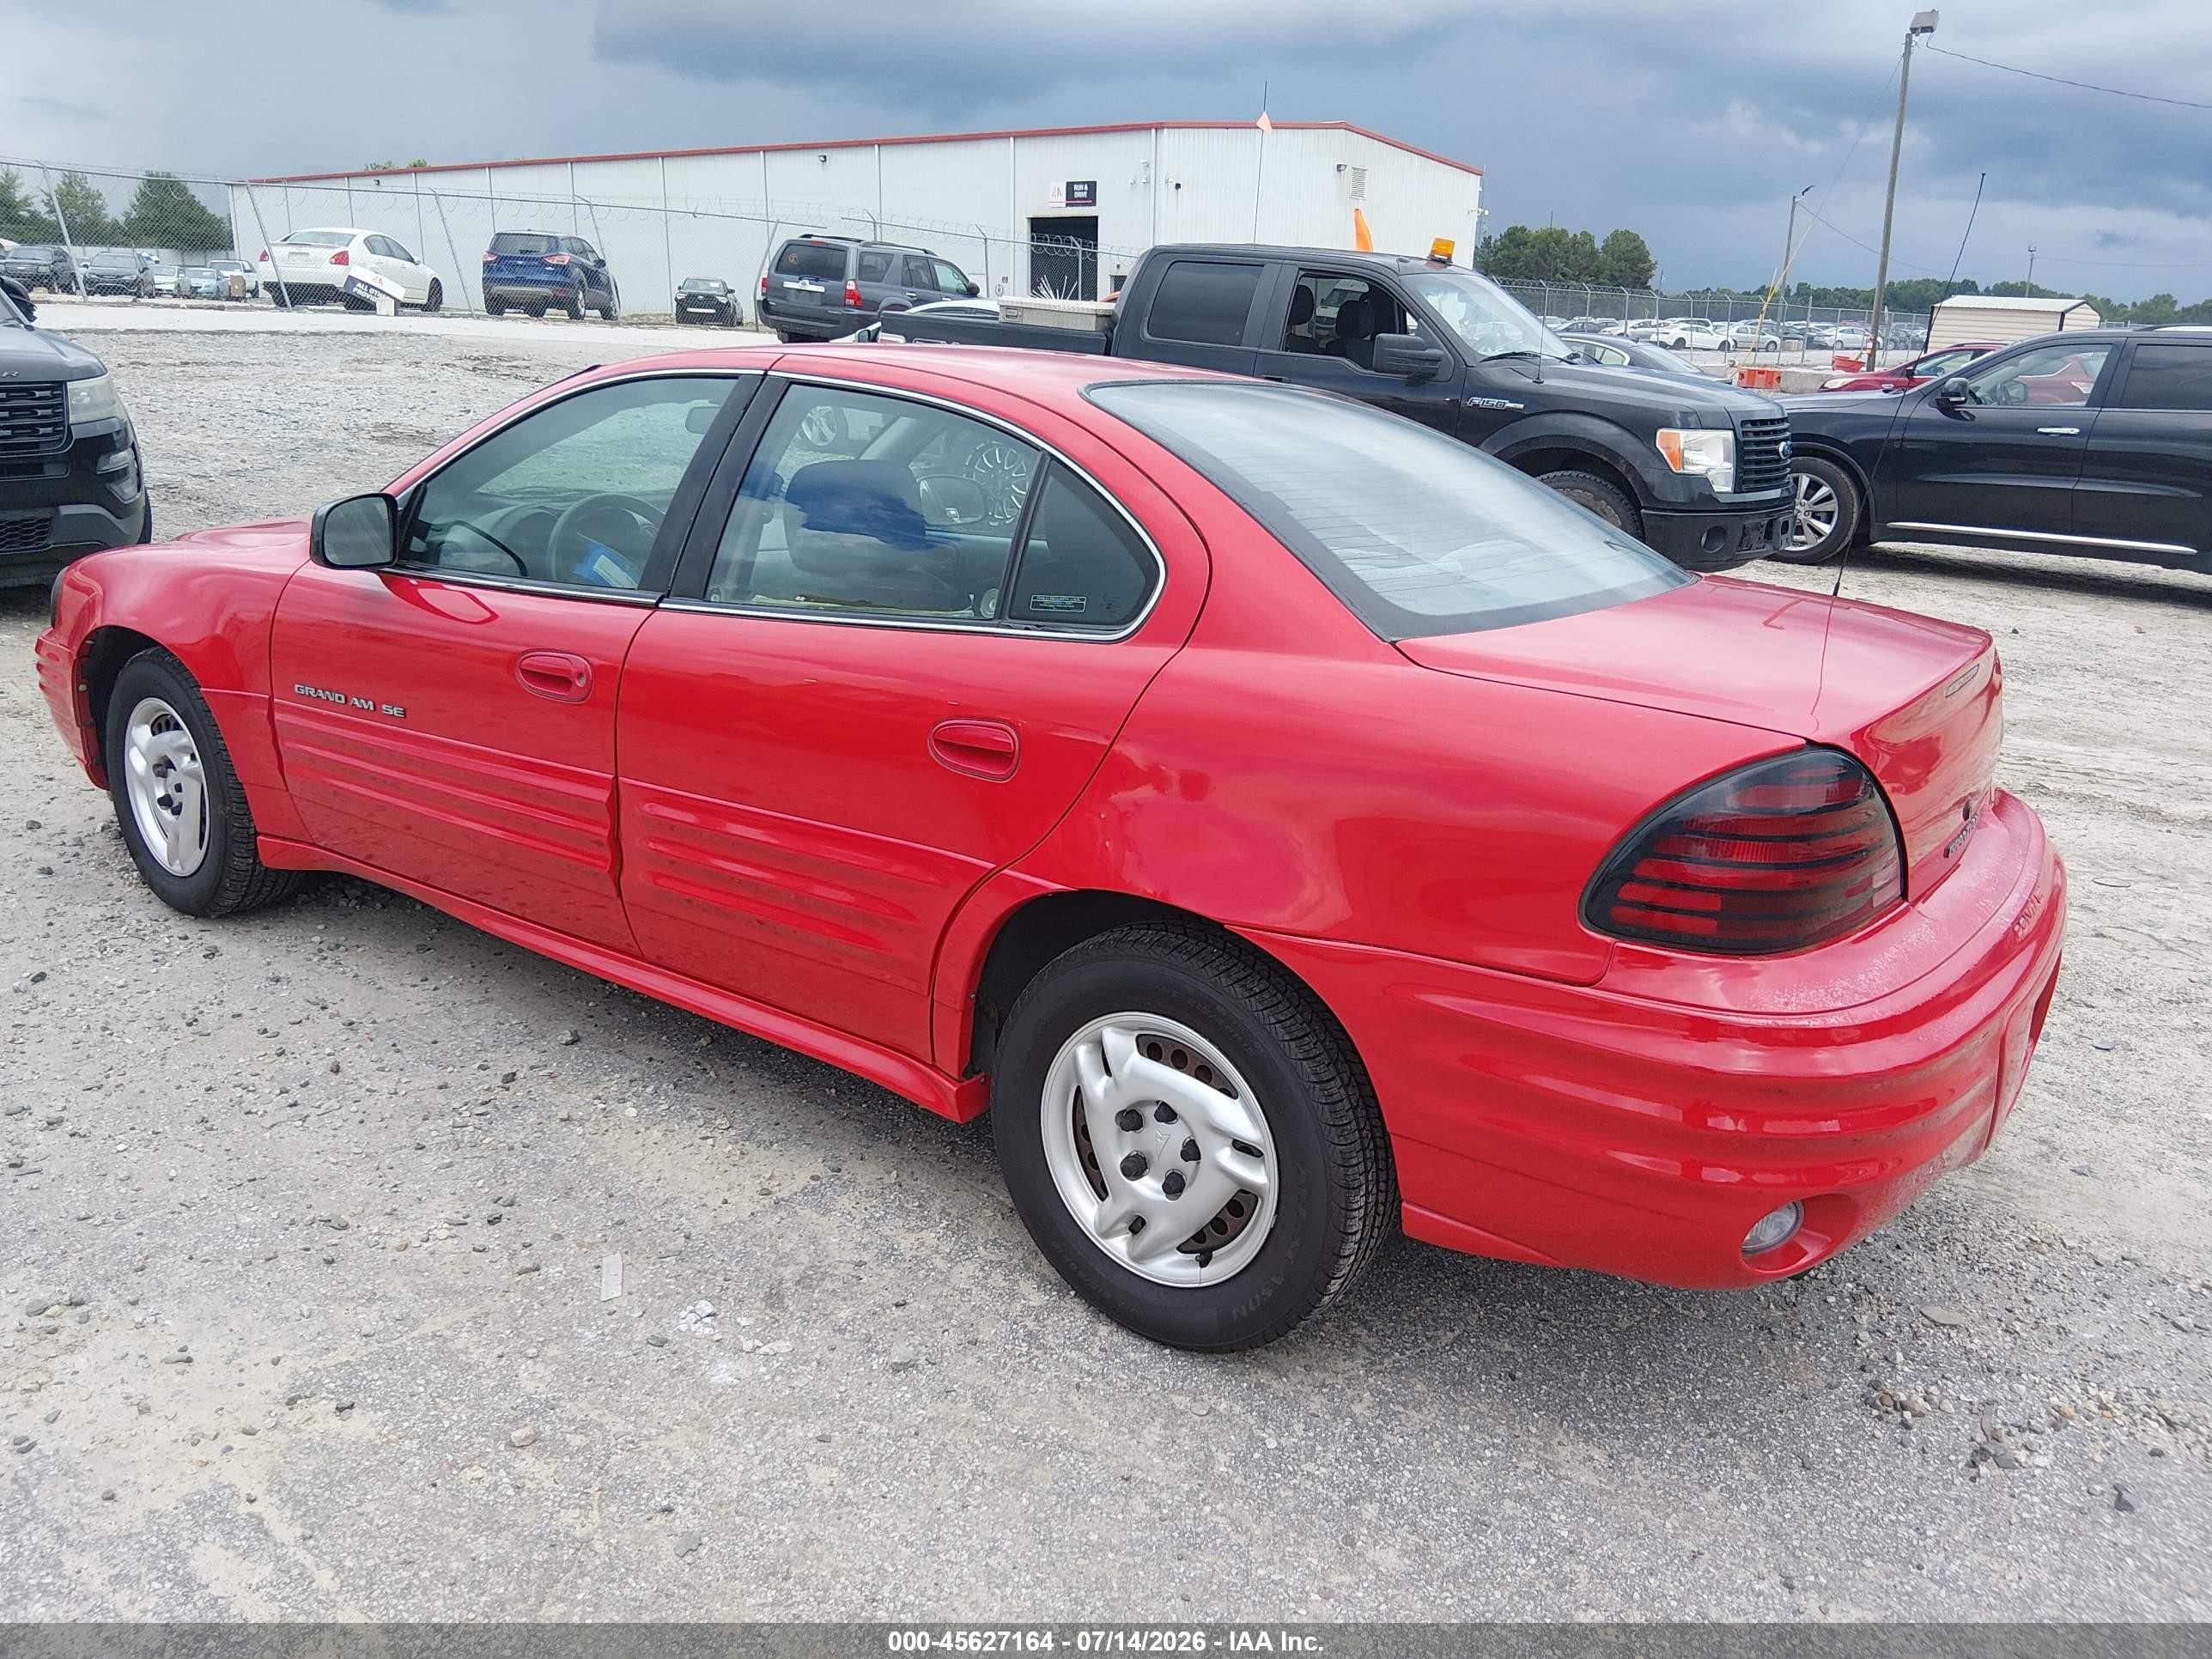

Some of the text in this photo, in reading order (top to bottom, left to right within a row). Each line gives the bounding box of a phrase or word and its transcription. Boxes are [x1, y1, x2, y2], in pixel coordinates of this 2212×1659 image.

[353, 287, 378, 302] PROVID
[356, 283, 368, 292] ALL
[295, 684, 405, 718] GRAND AM SE
